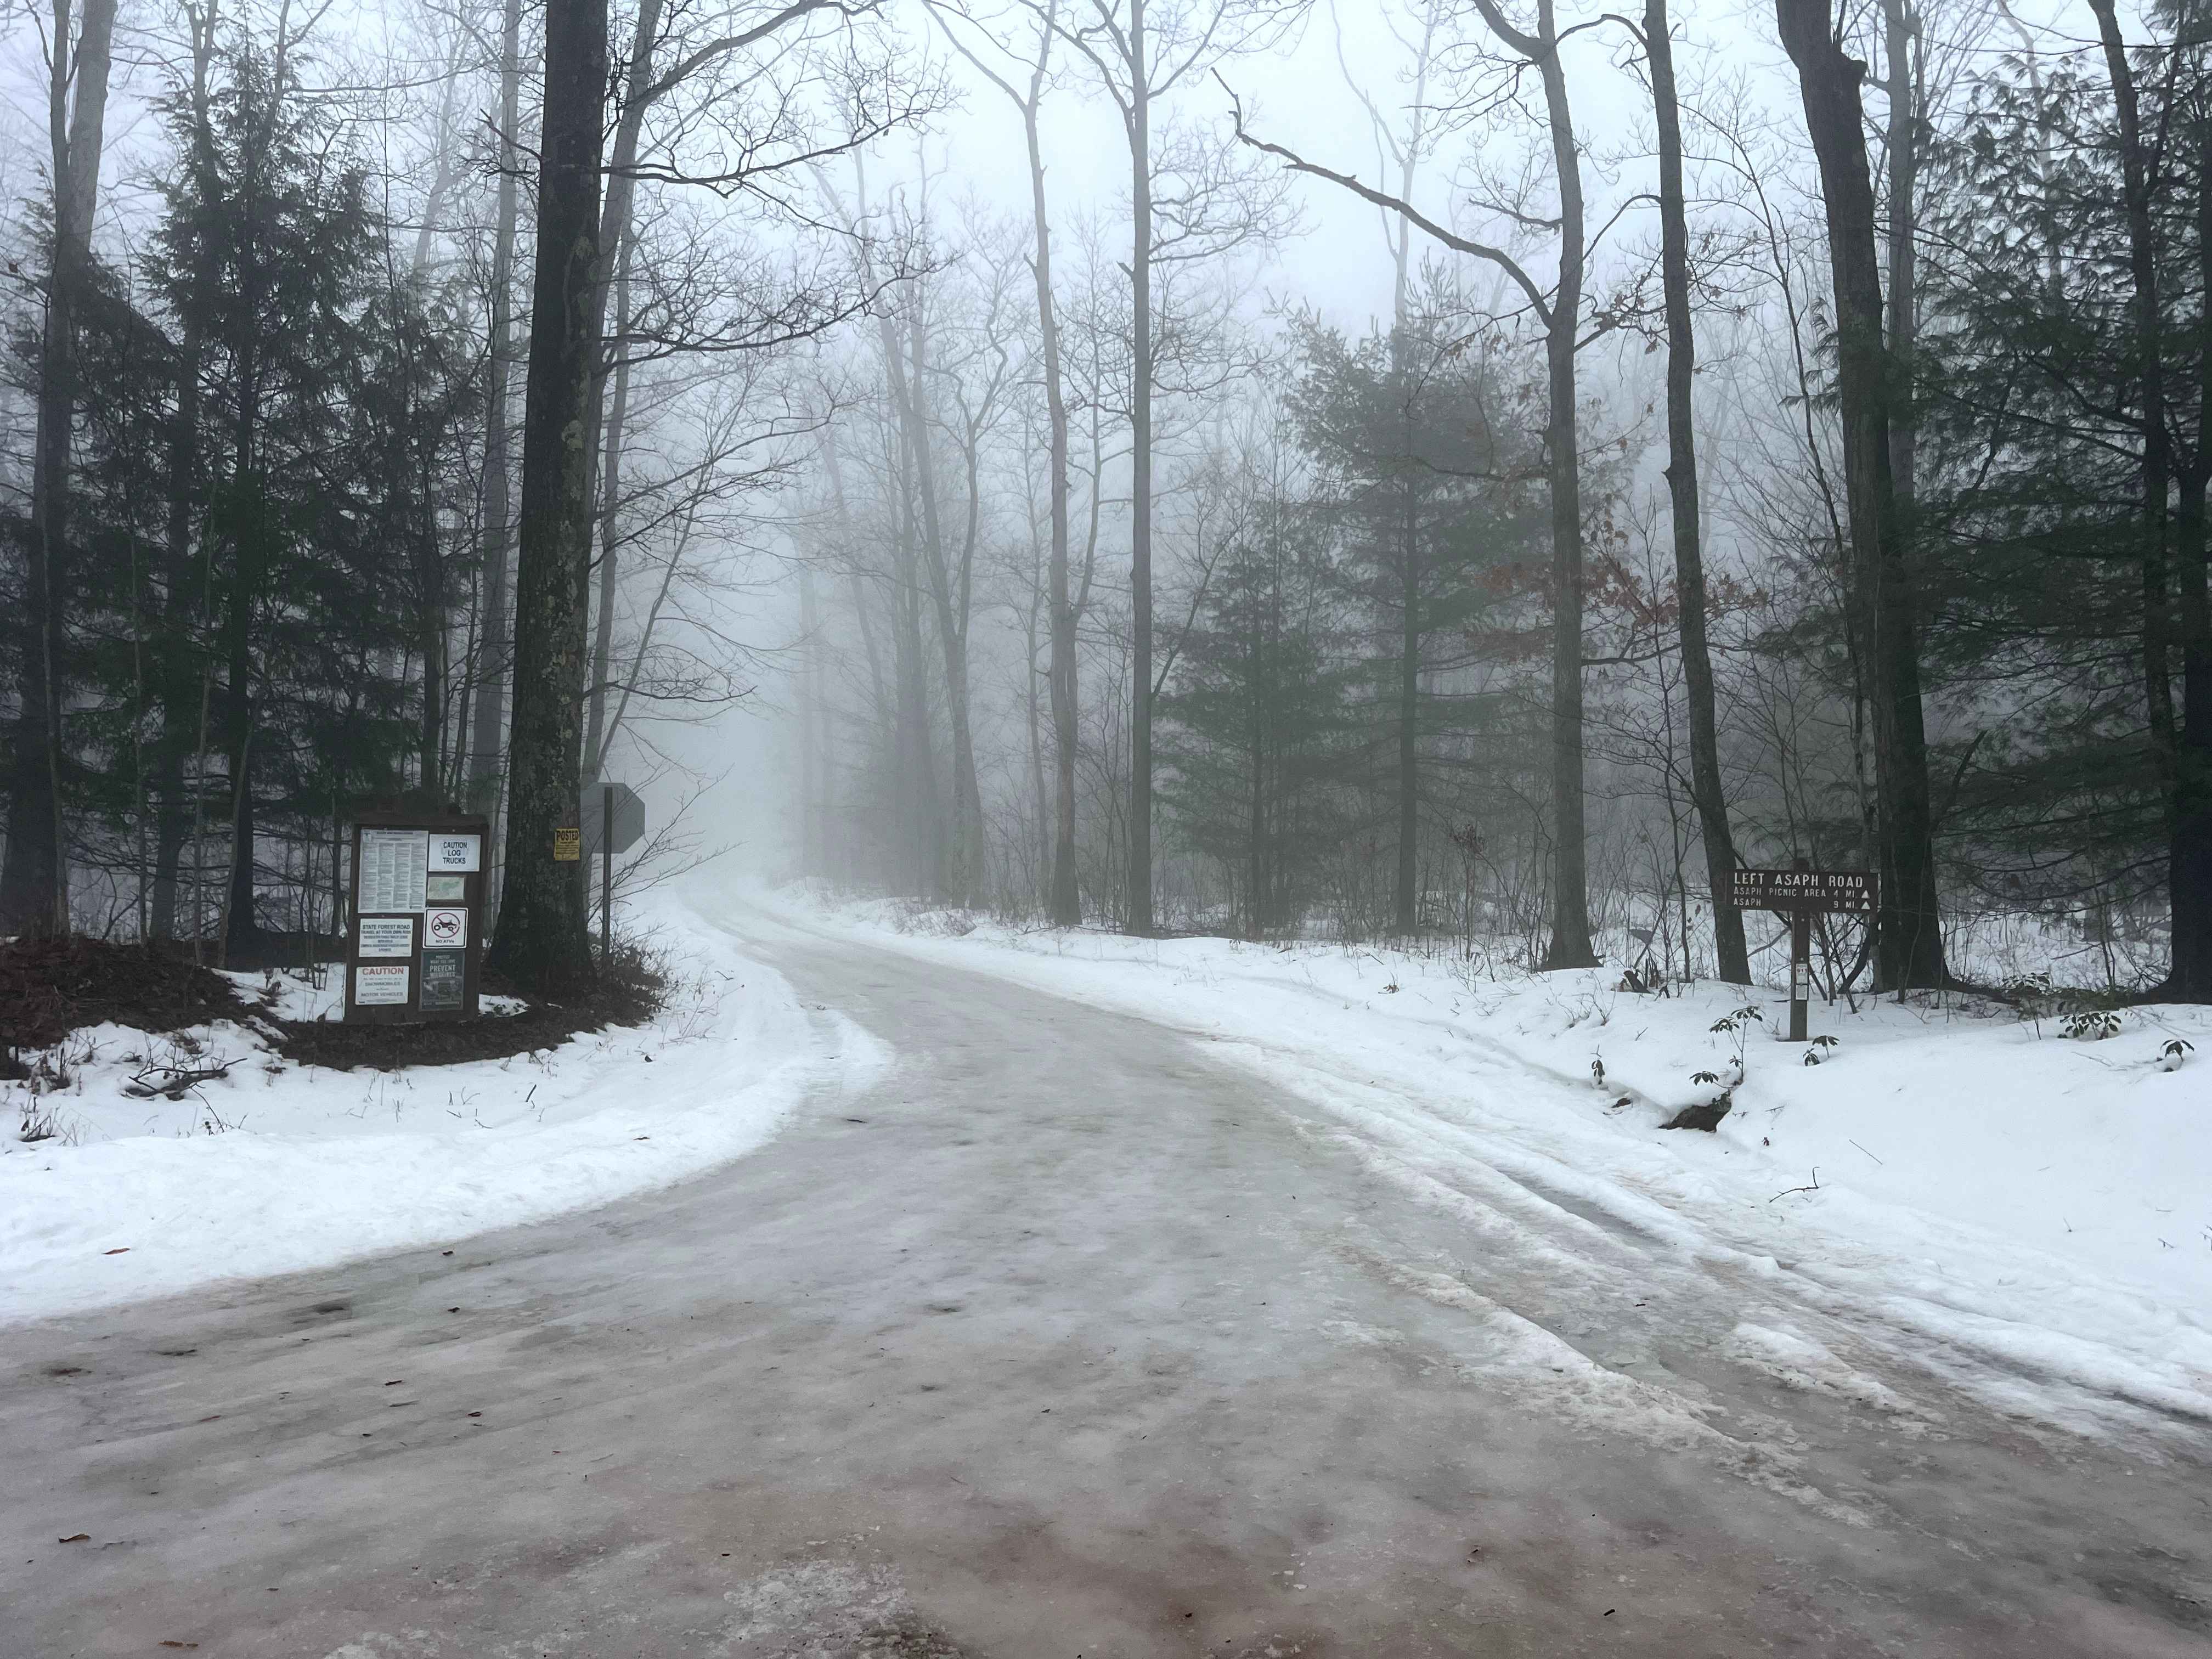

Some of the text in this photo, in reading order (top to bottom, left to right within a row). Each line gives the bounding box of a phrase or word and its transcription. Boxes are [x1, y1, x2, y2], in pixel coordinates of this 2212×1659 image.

[557, 830, 579, 840] POSTED
[1734, 872, 1863, 888] LEFT ASAPH ROAD
[1734, 886, 1762, 896] ASAPH
[1769, 888, 1797, 897] PICNIC
[1804, 889, 1826, 898] AREA
[1734, 898, 1761, 906] ASAPH
[1833, 900, 1839, 909] 9
